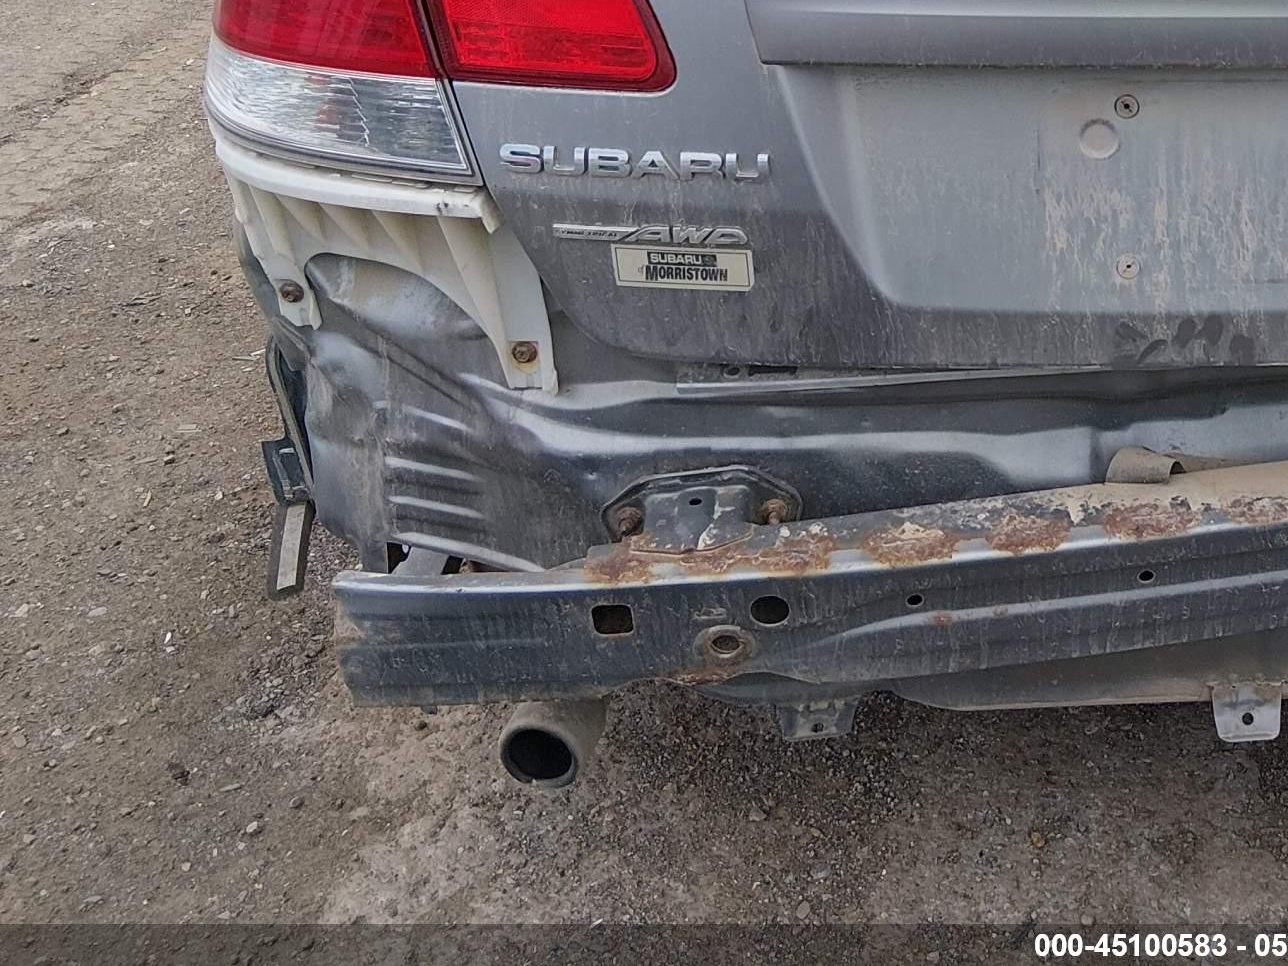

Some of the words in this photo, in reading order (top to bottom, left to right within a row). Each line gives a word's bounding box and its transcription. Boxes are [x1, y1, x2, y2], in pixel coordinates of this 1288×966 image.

[499, 143, 770, 181] SUBARU
[622, 225, 748, 245] AWD
[650, 253, 702, 265] SUBARU
[645, 265, 728, 282] MORRISTOWN
